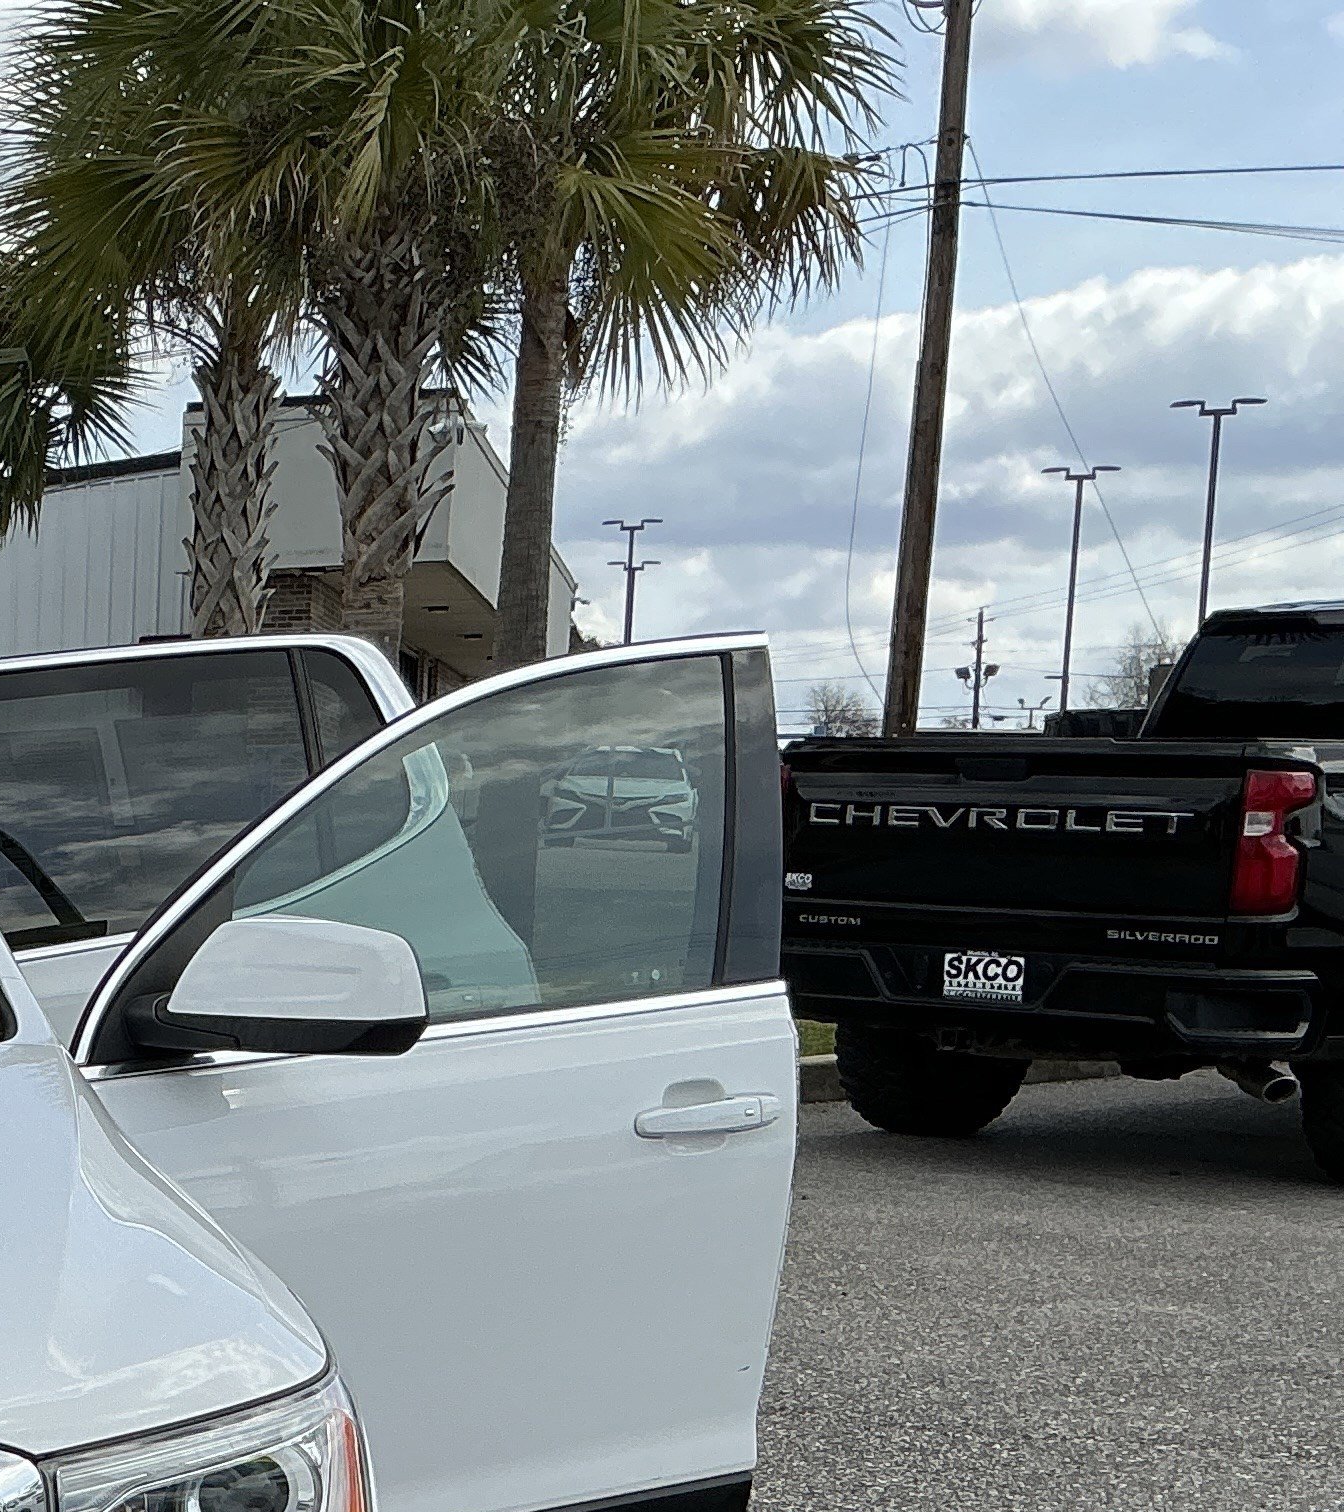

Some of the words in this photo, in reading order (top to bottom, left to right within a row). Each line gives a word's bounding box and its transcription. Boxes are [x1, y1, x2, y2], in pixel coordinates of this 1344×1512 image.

[809, 802, 1195, 835] CHEVROLET
[799, 914, 861, 926] CUSTOM
[1106, 929, 1219, 945] SILVERADO
[945, 955, 1024, 983] SKCO
